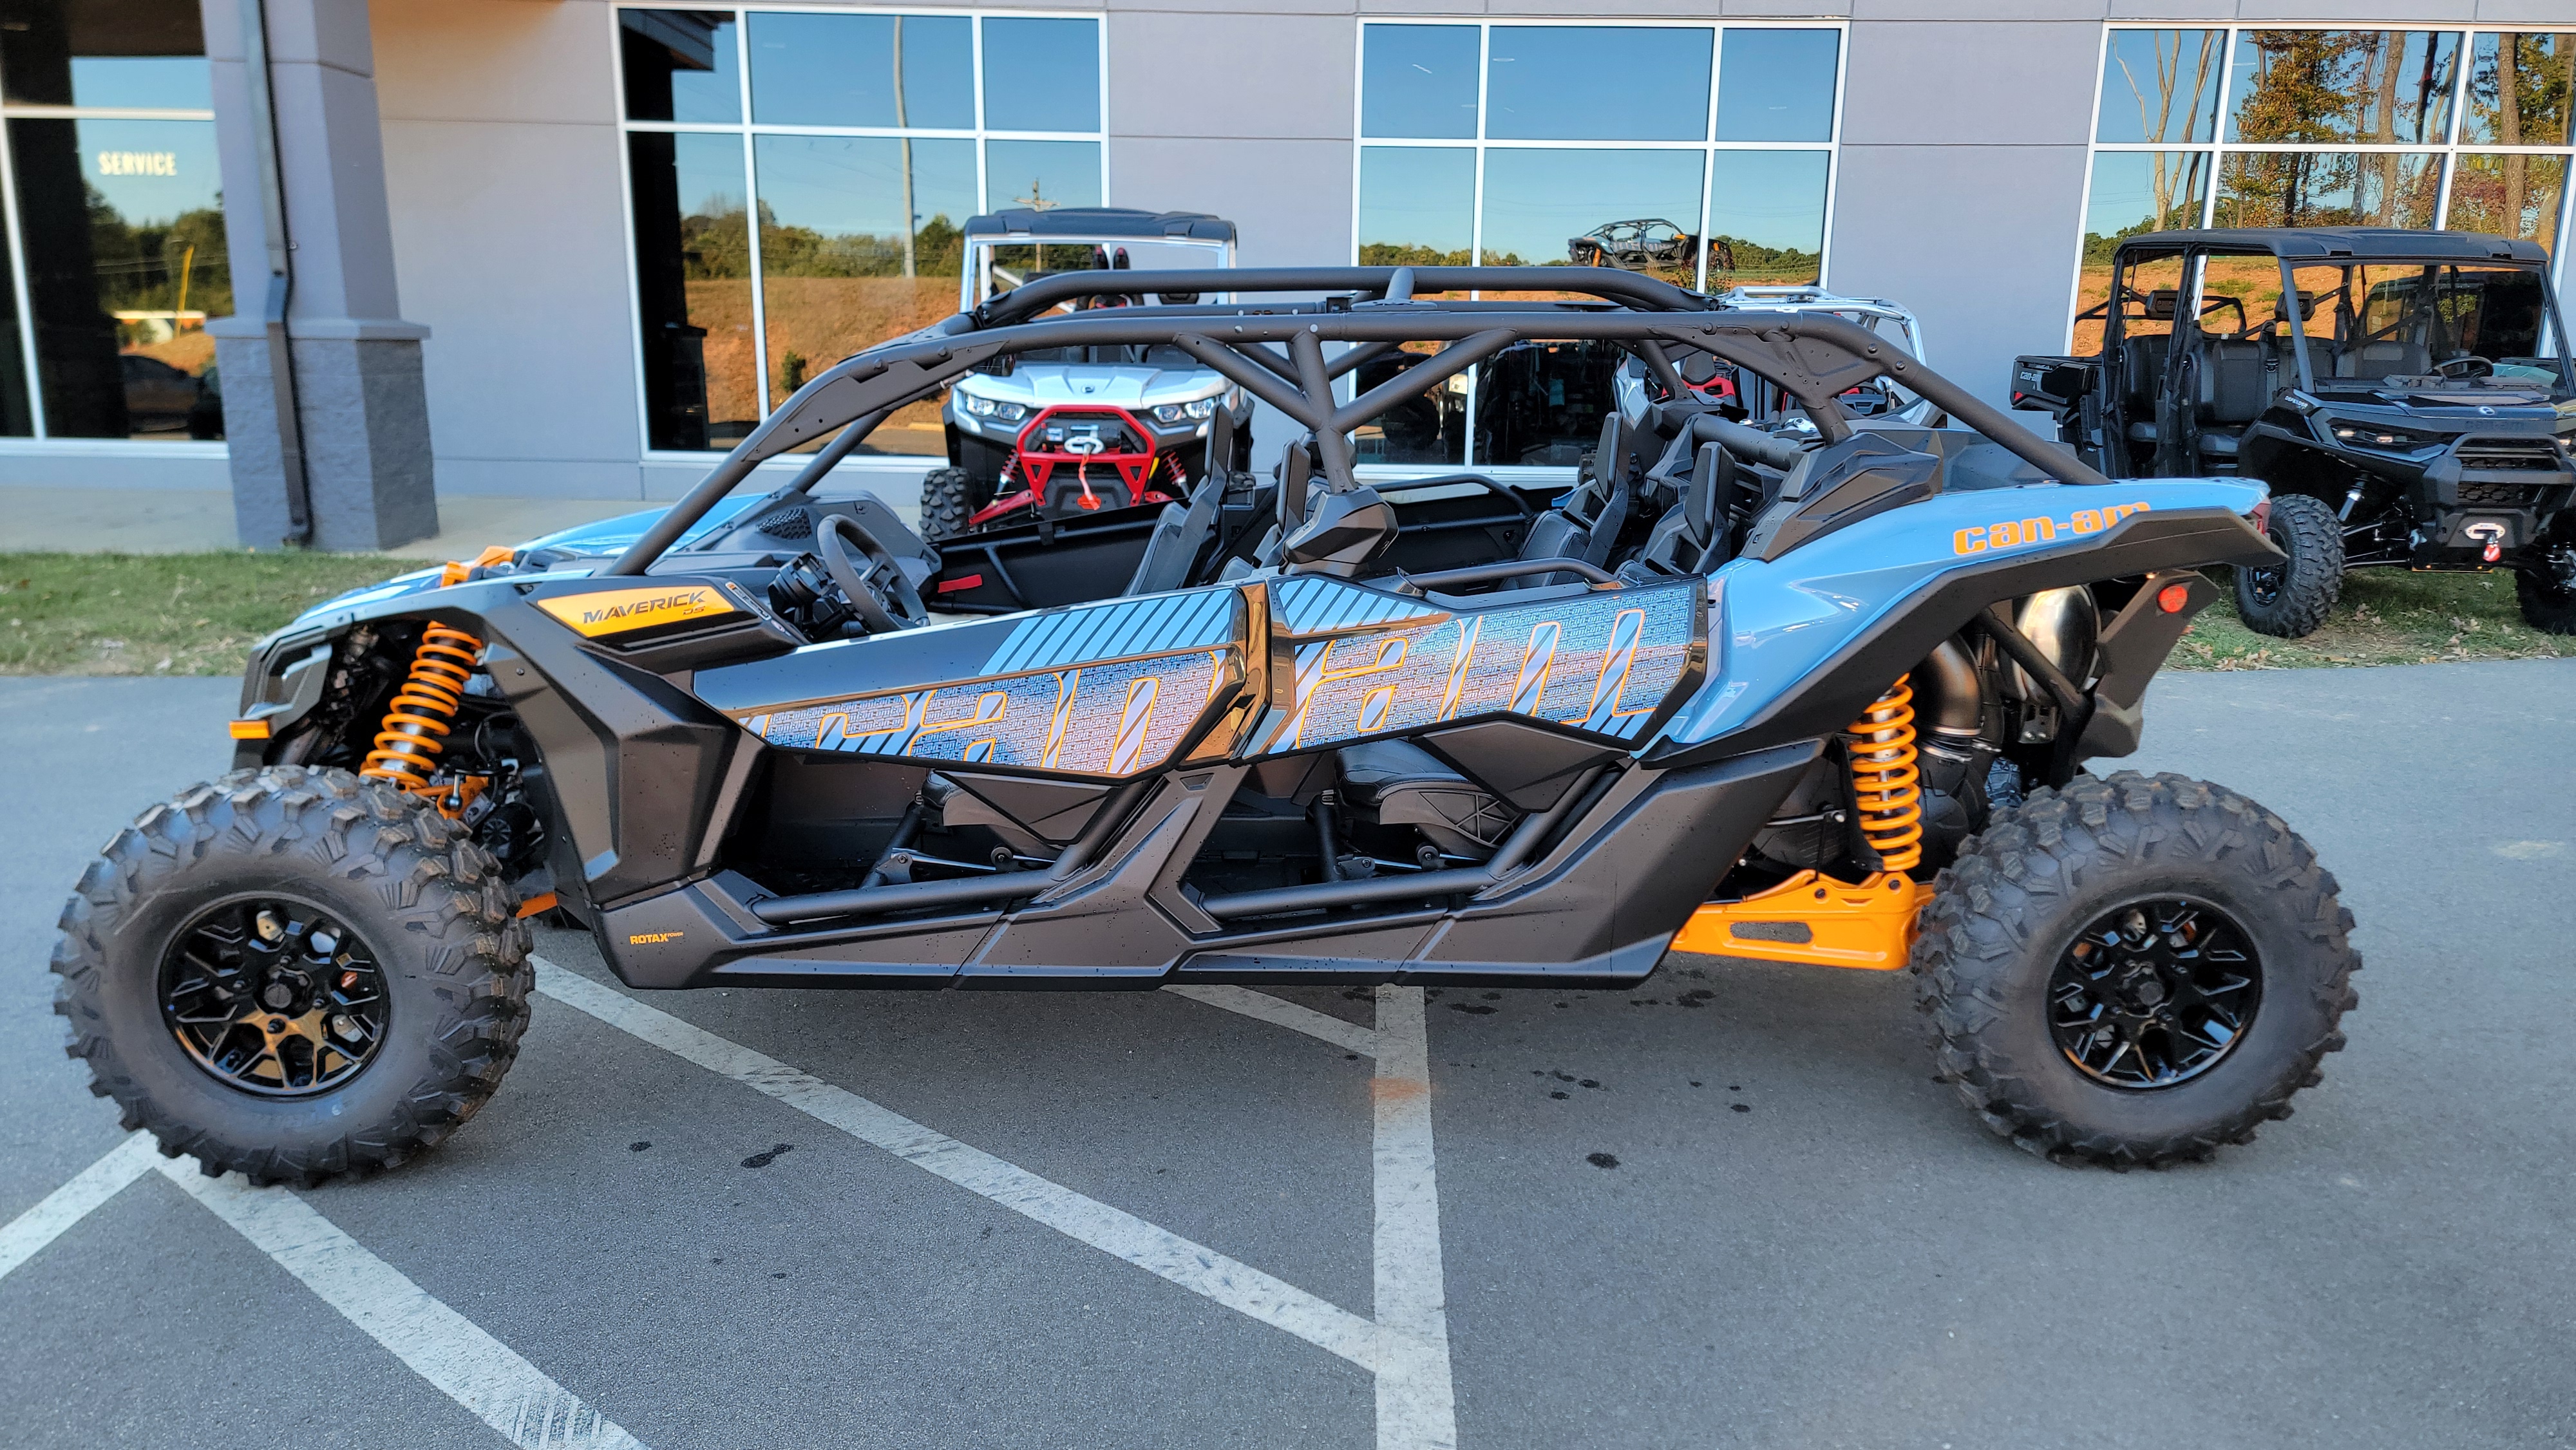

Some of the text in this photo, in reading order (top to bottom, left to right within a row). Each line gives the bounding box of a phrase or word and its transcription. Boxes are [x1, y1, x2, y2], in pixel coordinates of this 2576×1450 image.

[99, 151, 176, 176] SERVICE
[1954, 502, 2151, 555] can-am
[583, 590, 706, 624] MAVERICK
[683, 606, 705, 616] DS
[630, 933, 668, 945] ROTAX
